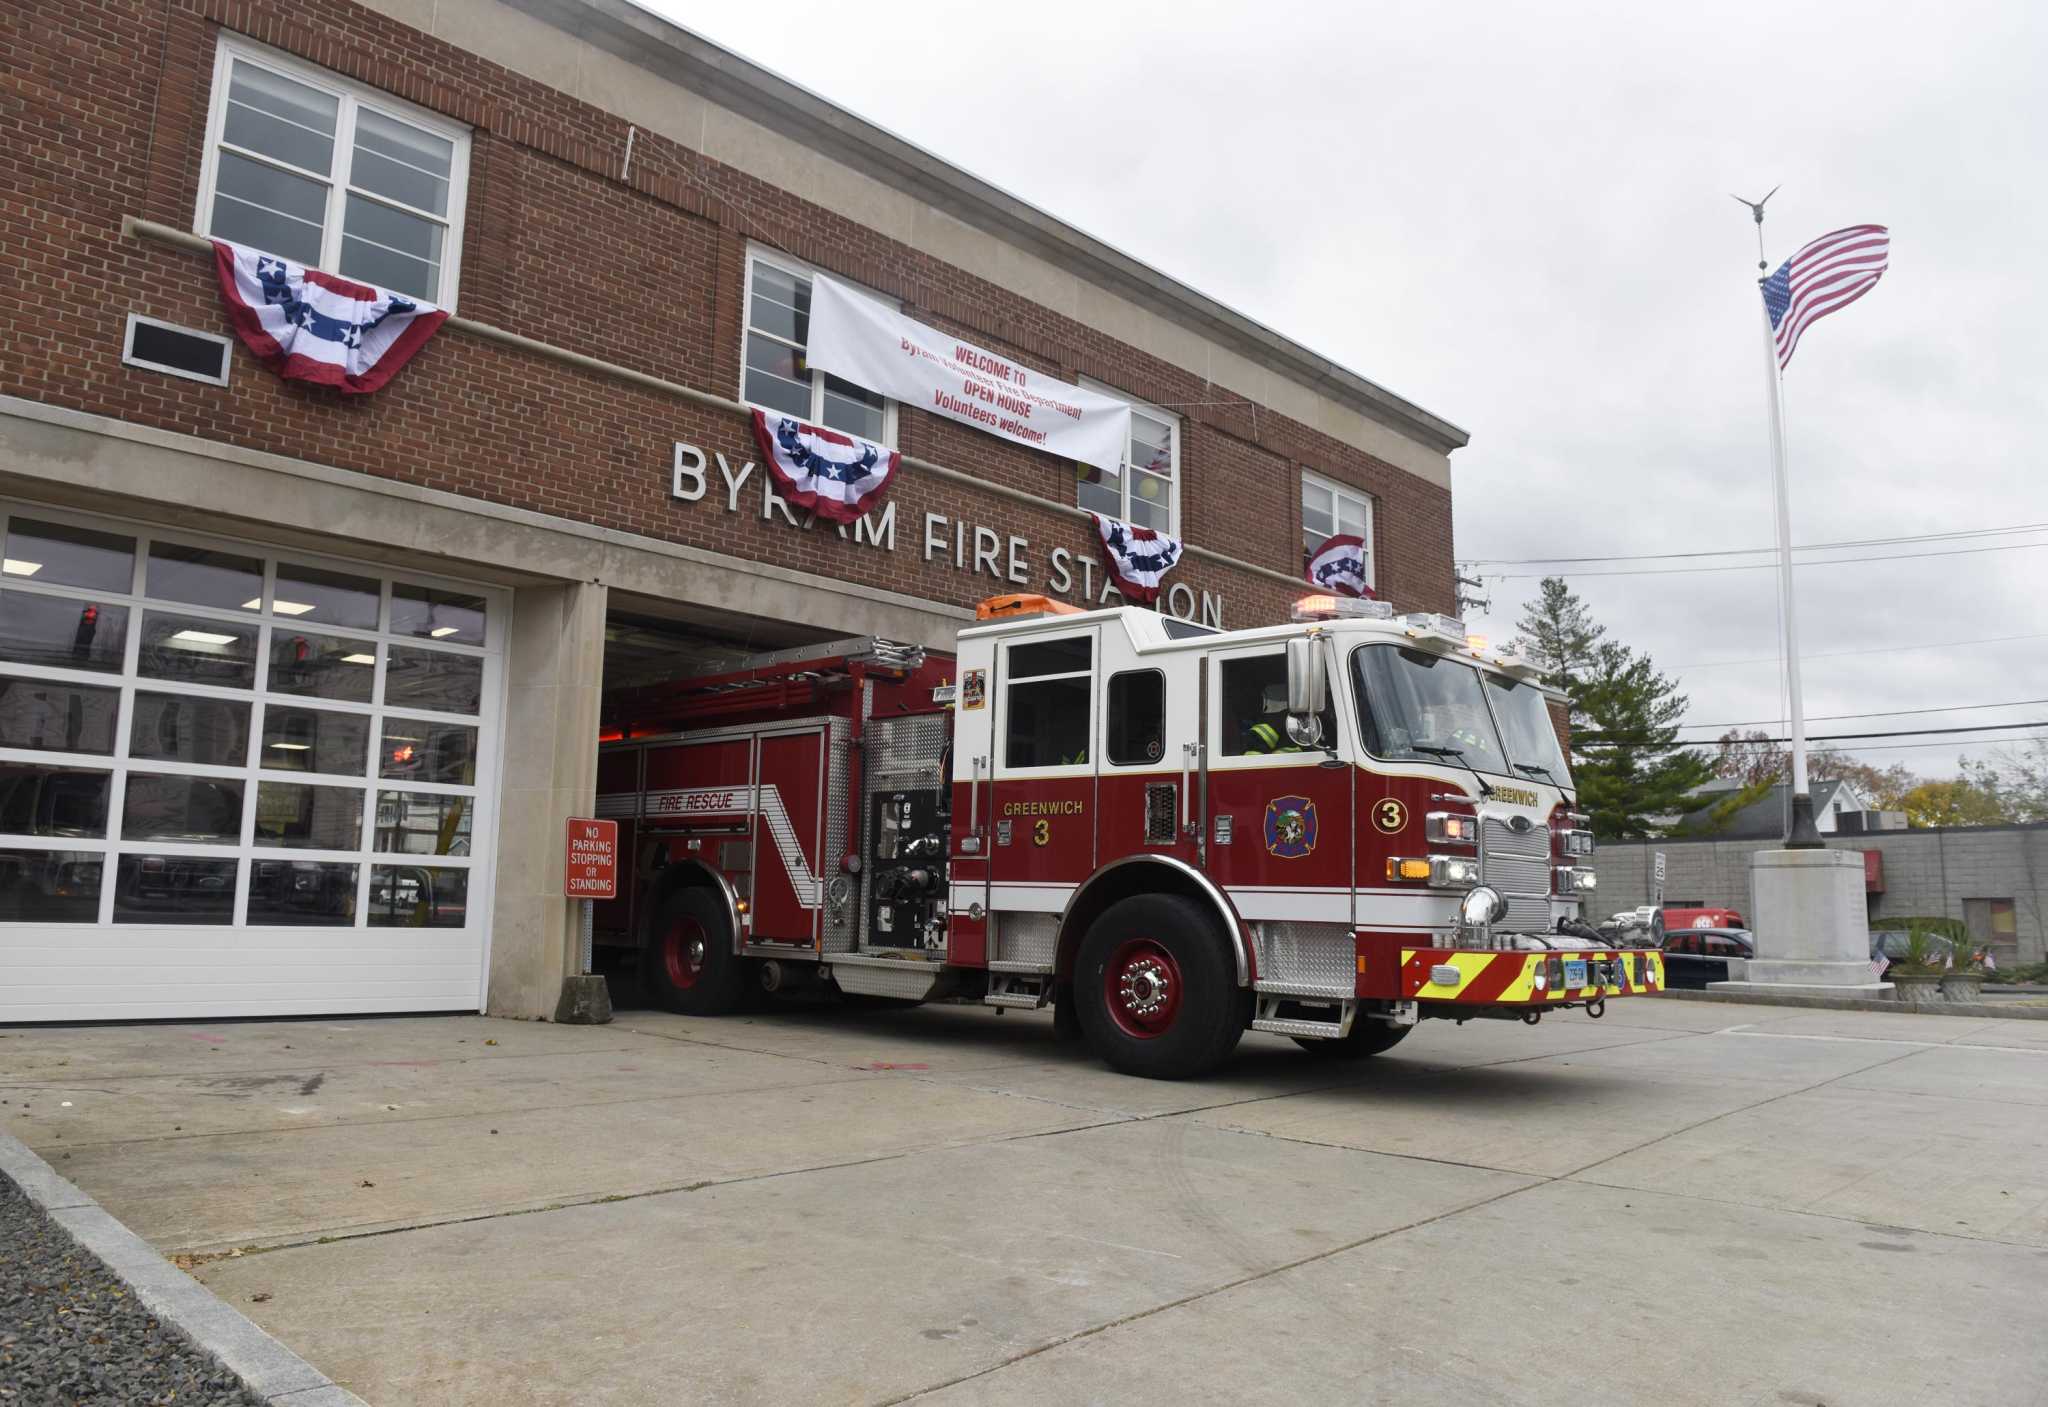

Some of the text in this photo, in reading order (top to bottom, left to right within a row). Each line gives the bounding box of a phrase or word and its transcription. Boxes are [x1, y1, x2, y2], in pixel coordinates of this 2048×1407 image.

[955, 345, 1026, 387] WELCOME TO
[964, 380, 1032, 418] OPEN HOUSE
[935, 389, 1047, 446] Volunteers welcome!
[672, 441, 897, 551] BYRM
[925, 512, 1030, 584] FIRE
[659, 792, 734, 811] FIRE RESCUE
[1003, 801, 1084, 816] GREENWICH
[1381, 802, 1401, 828] 3
[585, 826, 599, 839] NO
[1034, 819, 1050, 847] 3
[572, 839, 612, 854] PARKING
[571, 852, 612, 867] STOPPING
[586, 866, 597, 878] OR
[570, 878, 612, 892] STANDING
